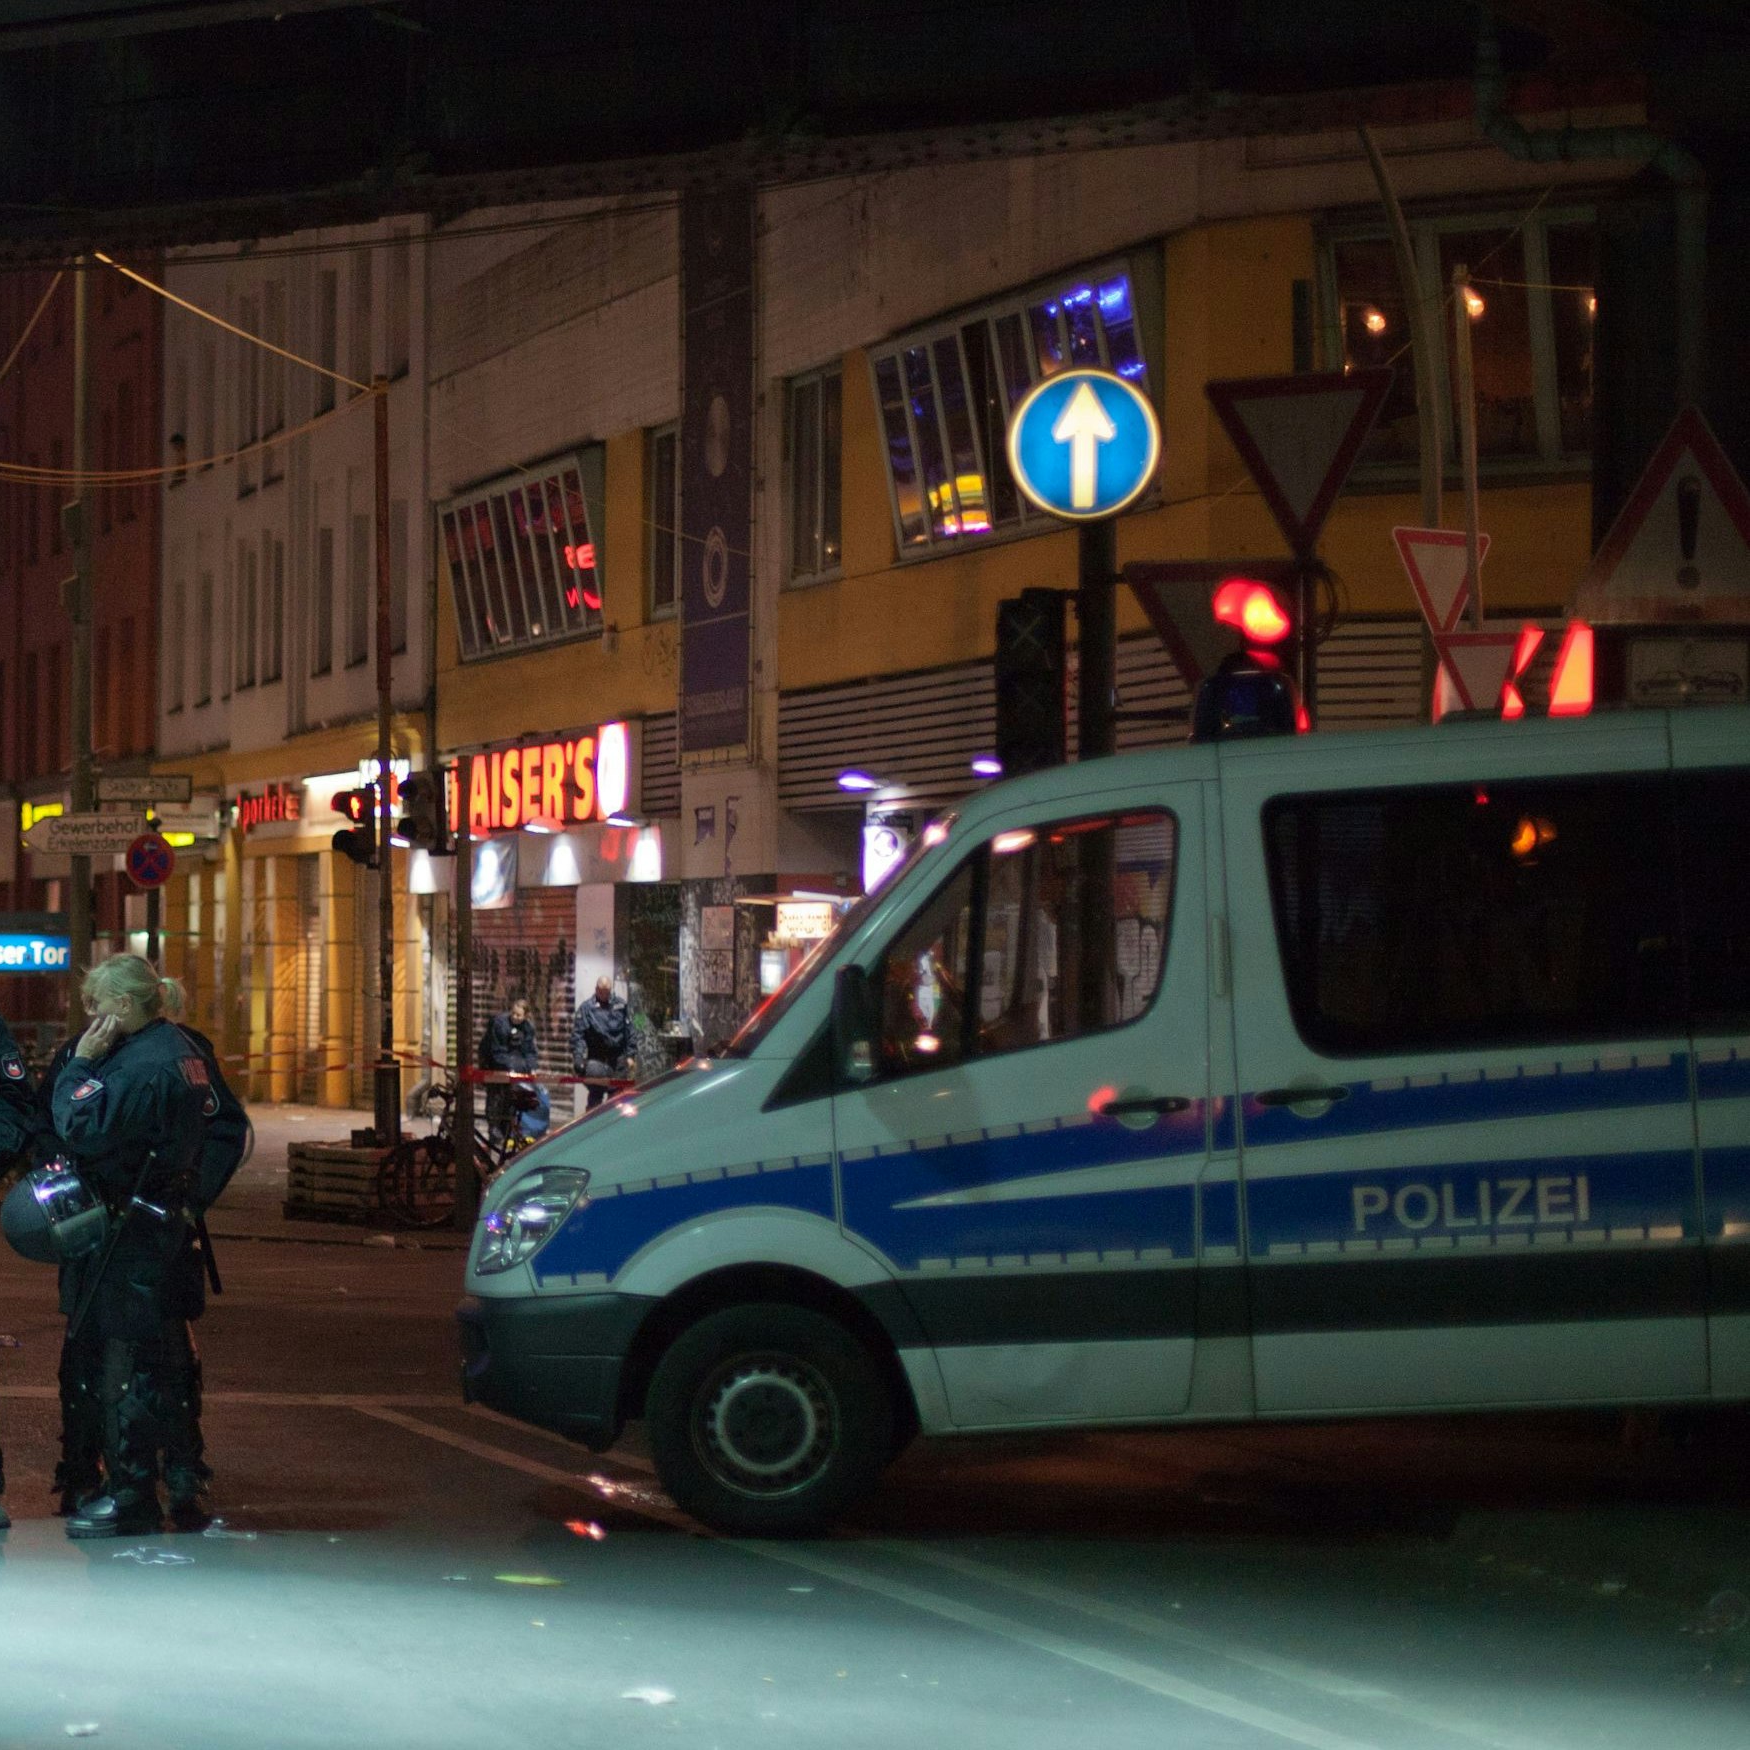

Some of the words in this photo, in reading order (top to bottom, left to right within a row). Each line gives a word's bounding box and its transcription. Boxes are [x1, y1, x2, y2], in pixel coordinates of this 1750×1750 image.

[50, 818, 139, 834] Gewerbehof
[30, 941, 67, 965] Tor
[1352, 1174, 1591, 1232] POLIZEI
